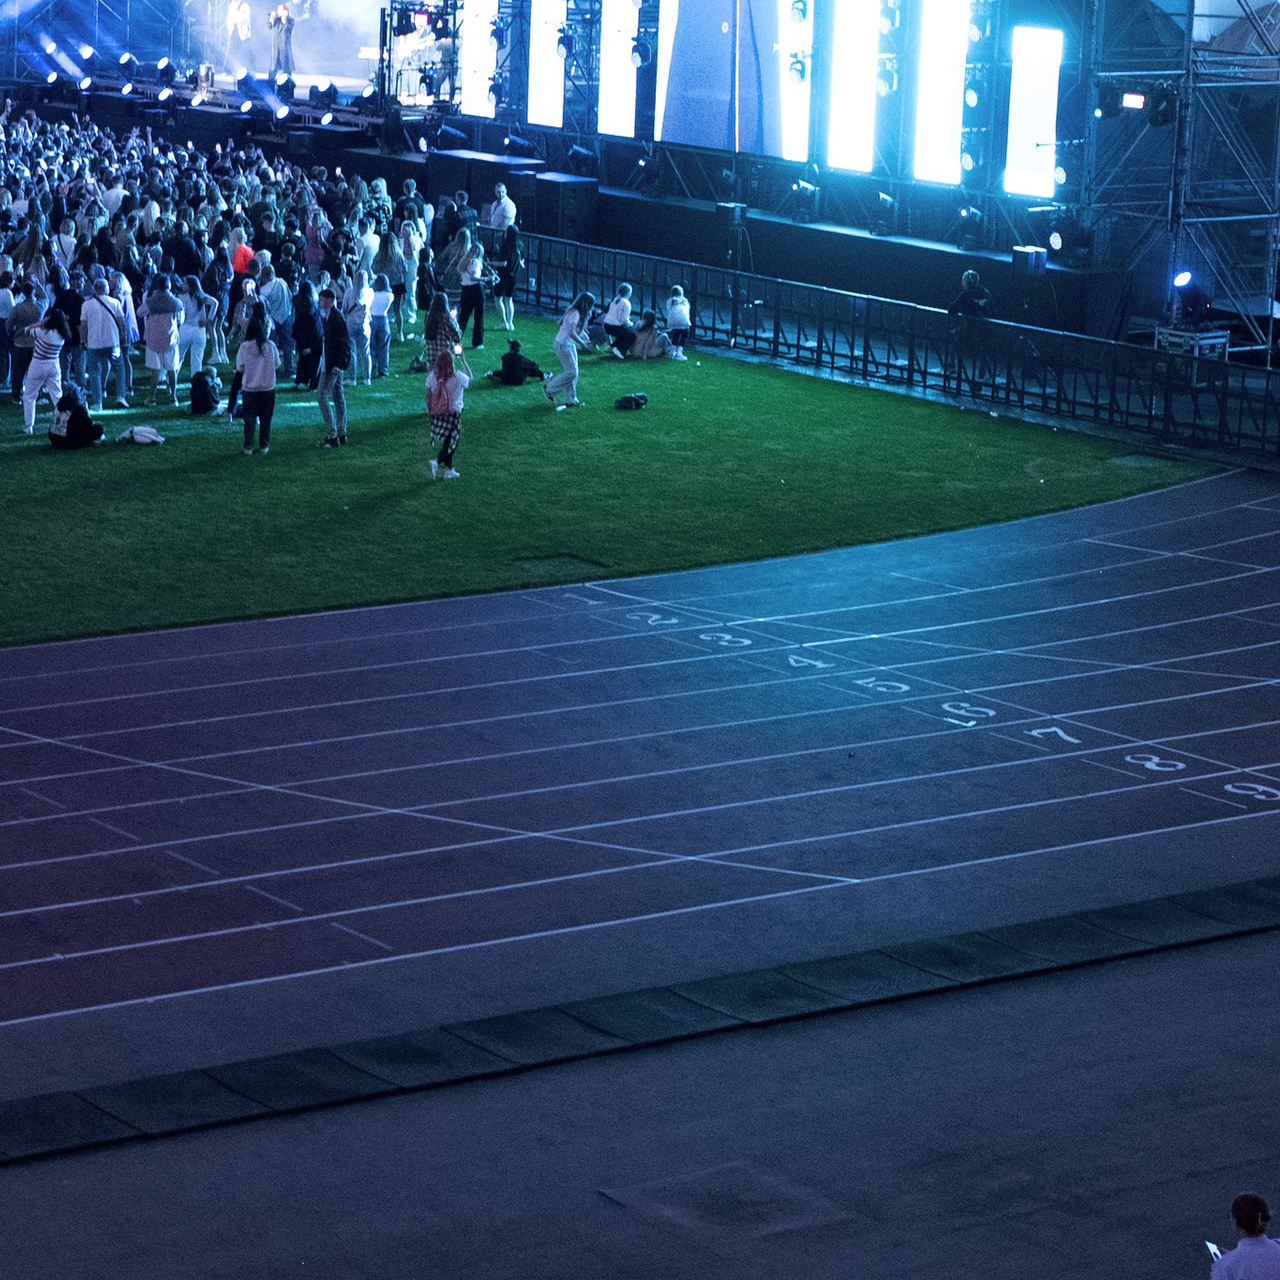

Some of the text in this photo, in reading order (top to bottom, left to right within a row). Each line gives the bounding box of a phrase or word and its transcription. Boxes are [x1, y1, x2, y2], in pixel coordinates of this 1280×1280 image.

[564, 592, 605, 605] 1
[626, 611, 679, 626] 2
[699, 632, 752, 647] 3
[788, 654, 836, 669] 4
[851, 676, 910, 693] 5
[941, 701, 997, 718] 6
[1023, 726, 1082, 744] 7
[1124, 753, 1187, 771] 8
[1224, 782, 1280, 801] 9
